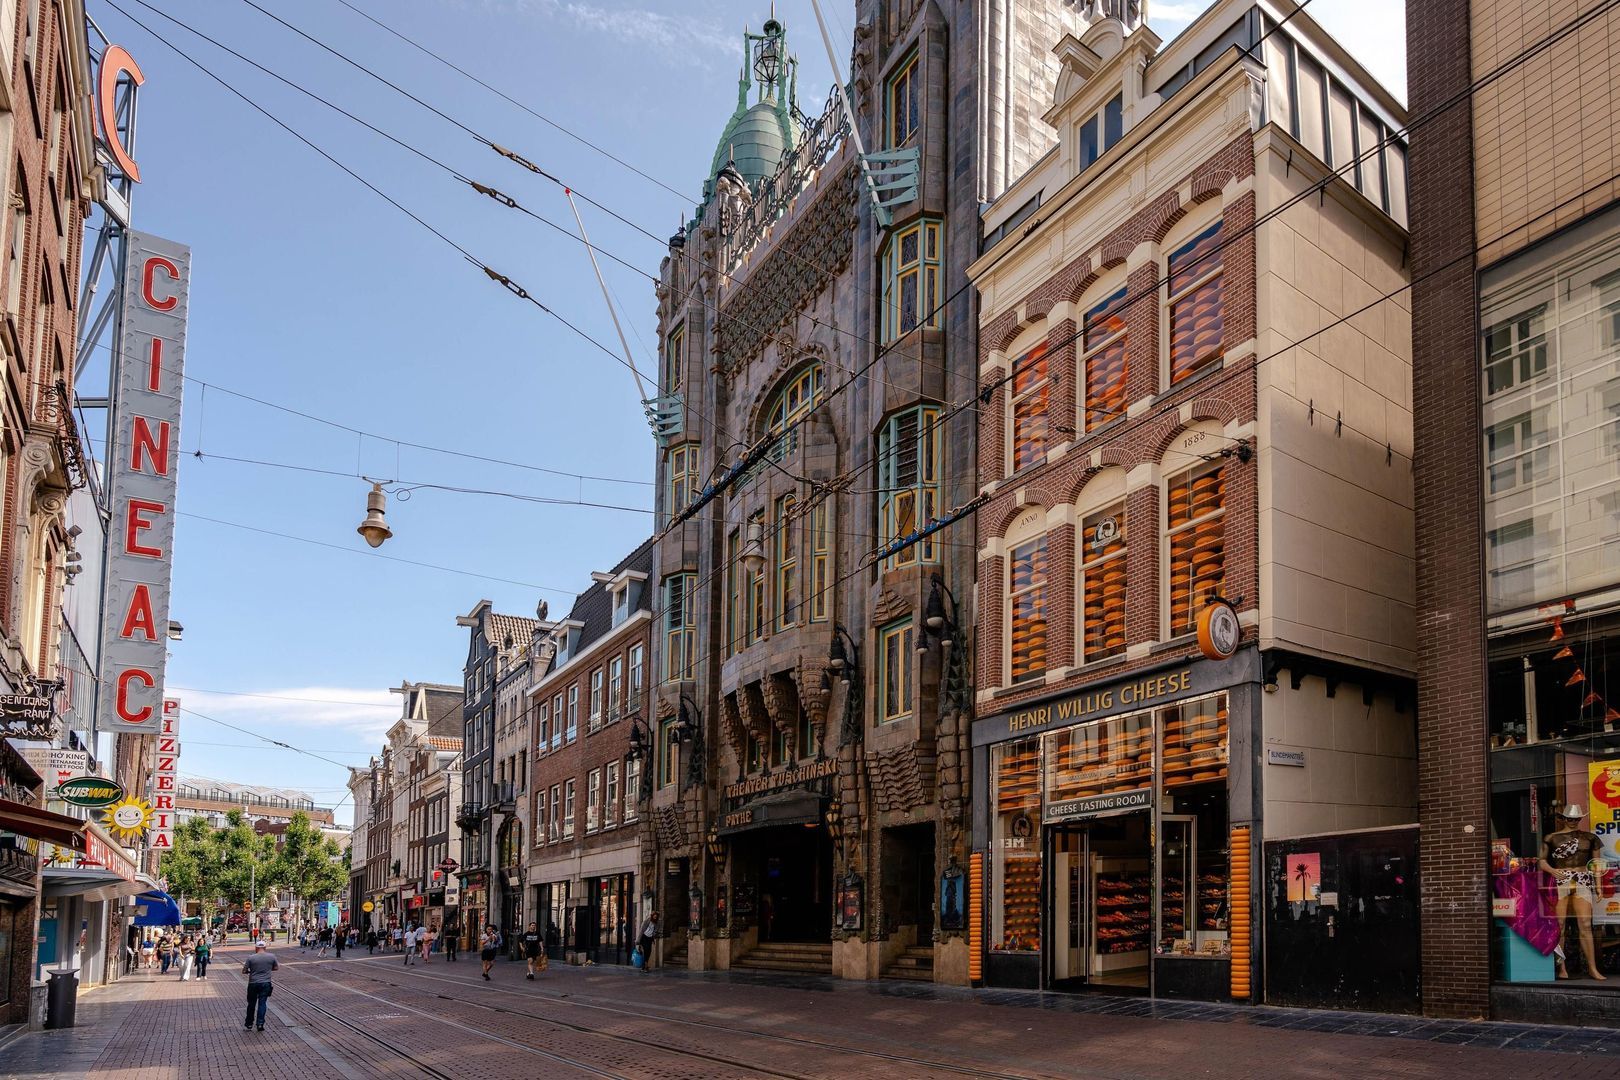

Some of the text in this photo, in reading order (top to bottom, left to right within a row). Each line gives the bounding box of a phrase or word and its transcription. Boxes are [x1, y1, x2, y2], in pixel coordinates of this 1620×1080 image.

[1183, 431, 1205, 448] 1888
[115, 257, 180, 723] CINEAC
[1019, 512, 1038, 528] ANNO
[1008, 670, 1192, 732] HENRI WILLIG CHEESE
[153, 700, 178, 847] PIZZERIA
[772, 759, 838, 789] TUSCHINSKI
[60, 786, 121, 798] SUBWAY
[1050, 793, 1145, 815] CHEESE TASTING ROOM
